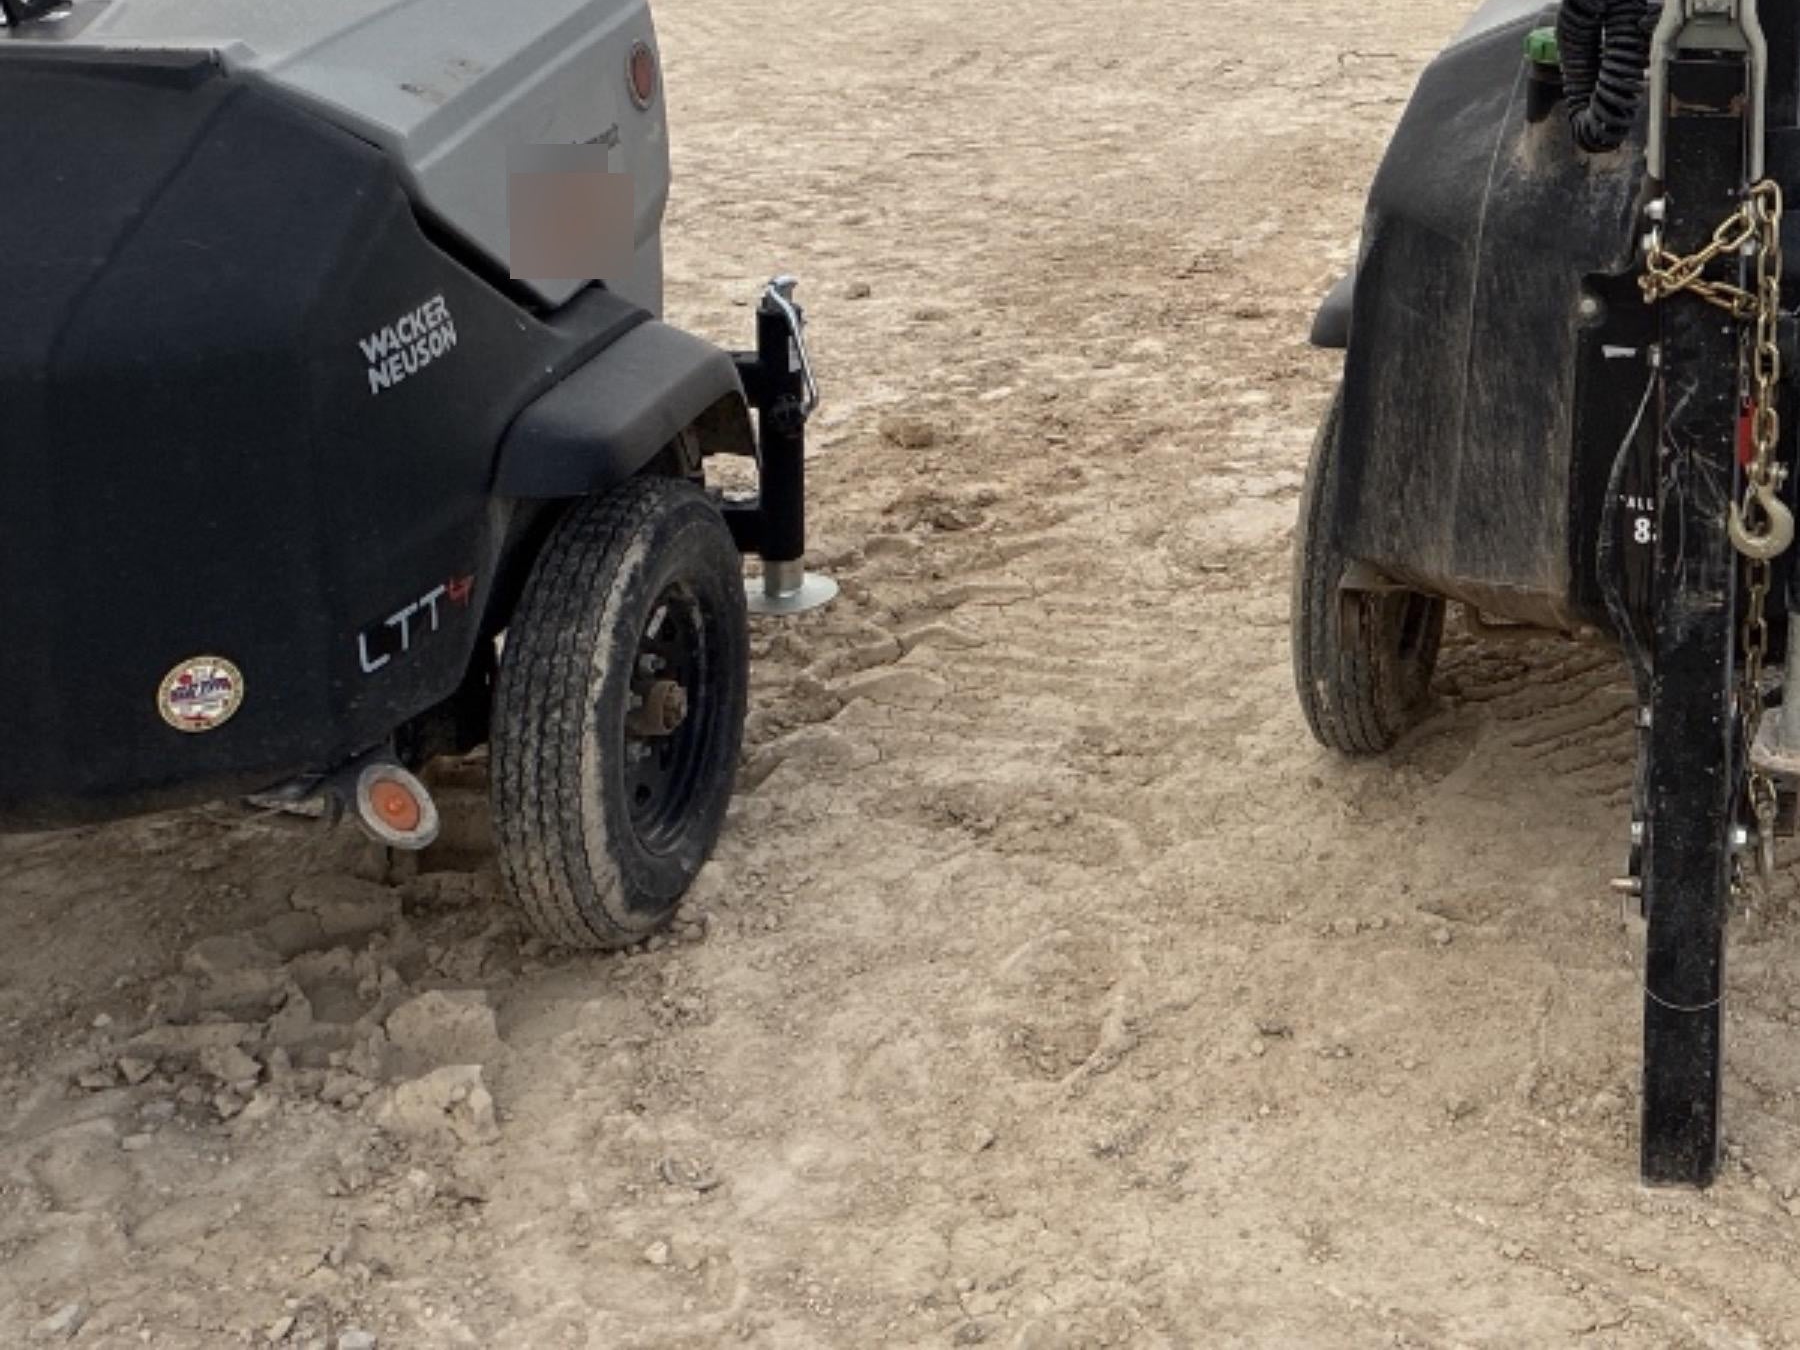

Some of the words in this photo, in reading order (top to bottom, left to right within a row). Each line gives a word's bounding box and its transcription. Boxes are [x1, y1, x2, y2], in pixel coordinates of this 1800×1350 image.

[359, 294, 450, 364] WACKER
[368, 319, 457, 394] NEUSON
[1620, 494, 1655, 511] ALL
